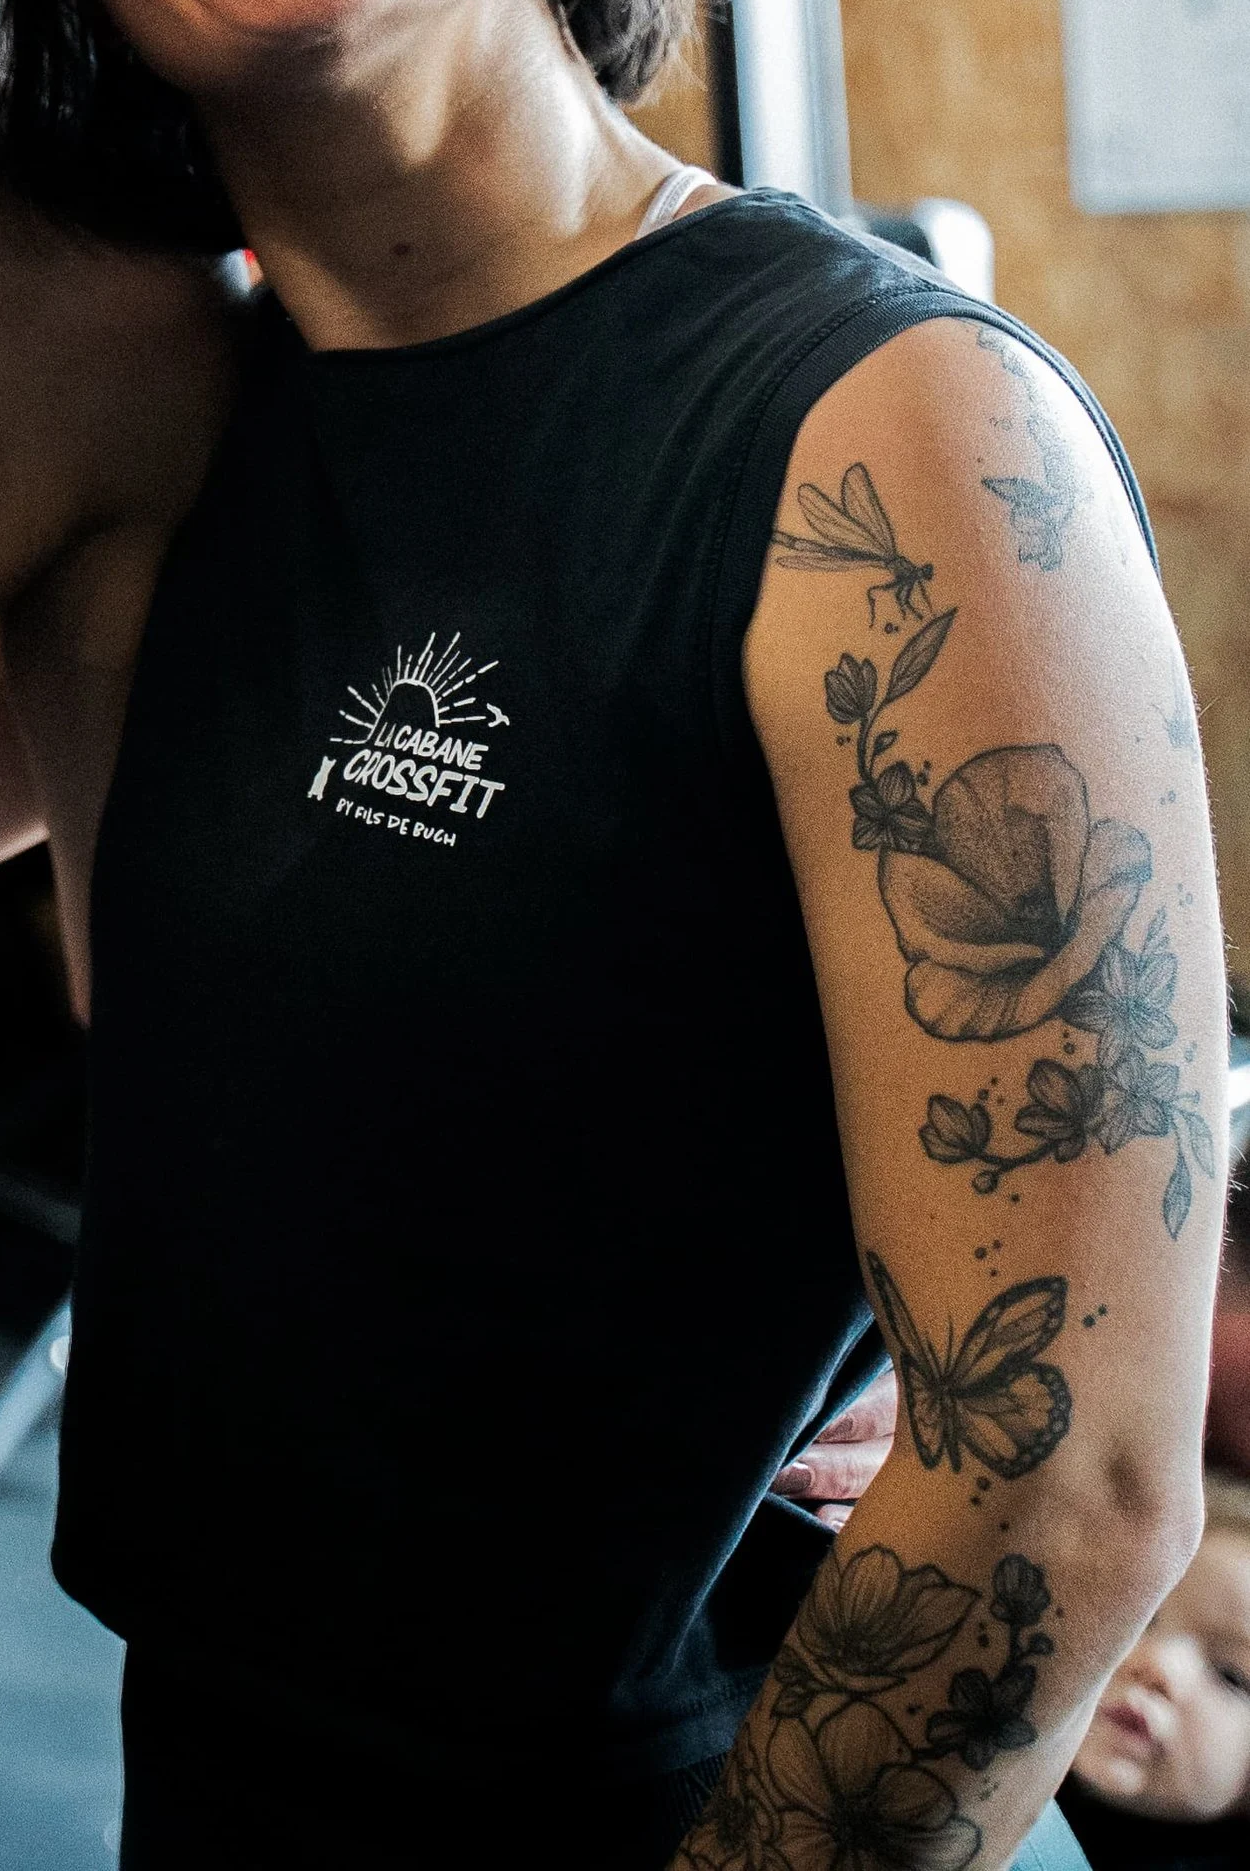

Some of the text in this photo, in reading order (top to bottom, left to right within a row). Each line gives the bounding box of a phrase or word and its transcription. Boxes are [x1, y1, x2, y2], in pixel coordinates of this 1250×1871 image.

[374, 721, 489, 771] LA CABANE
[343, 748, 506, 819] CROSSFIT
[335, 797, 457, 847] BY FILS DE BUCH
